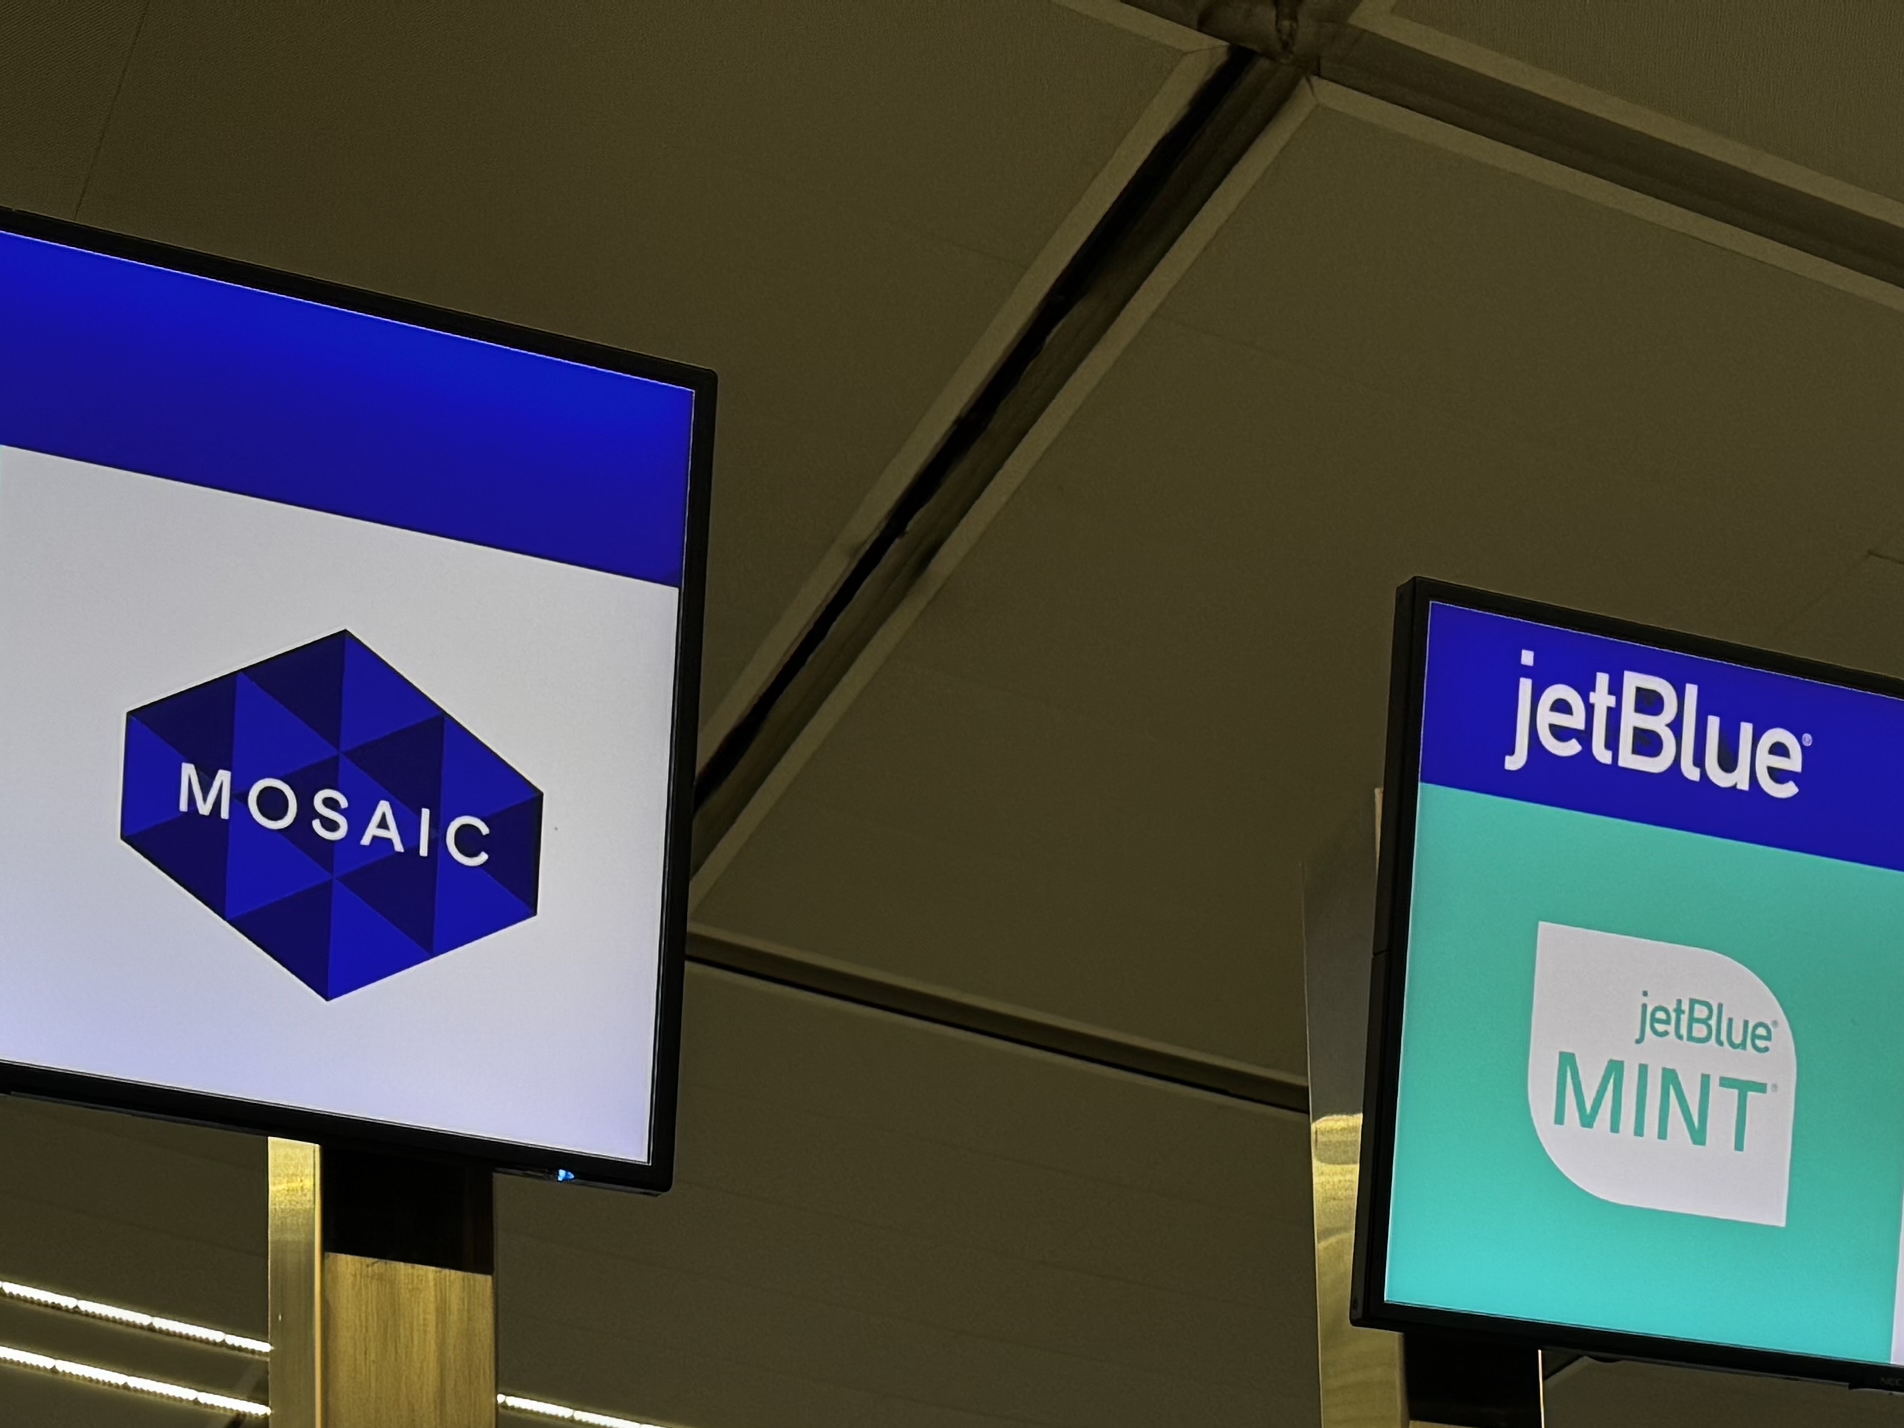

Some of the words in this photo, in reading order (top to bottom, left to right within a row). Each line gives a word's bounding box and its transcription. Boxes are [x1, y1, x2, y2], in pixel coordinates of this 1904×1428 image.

[1504, 649, 1802, 799] jetBlue
[179, 762, 490, 867] MOSAIC
[1635, 990, 1772, 1053] jetBlue
[1554, 1051, 1767, 1151] MINT
